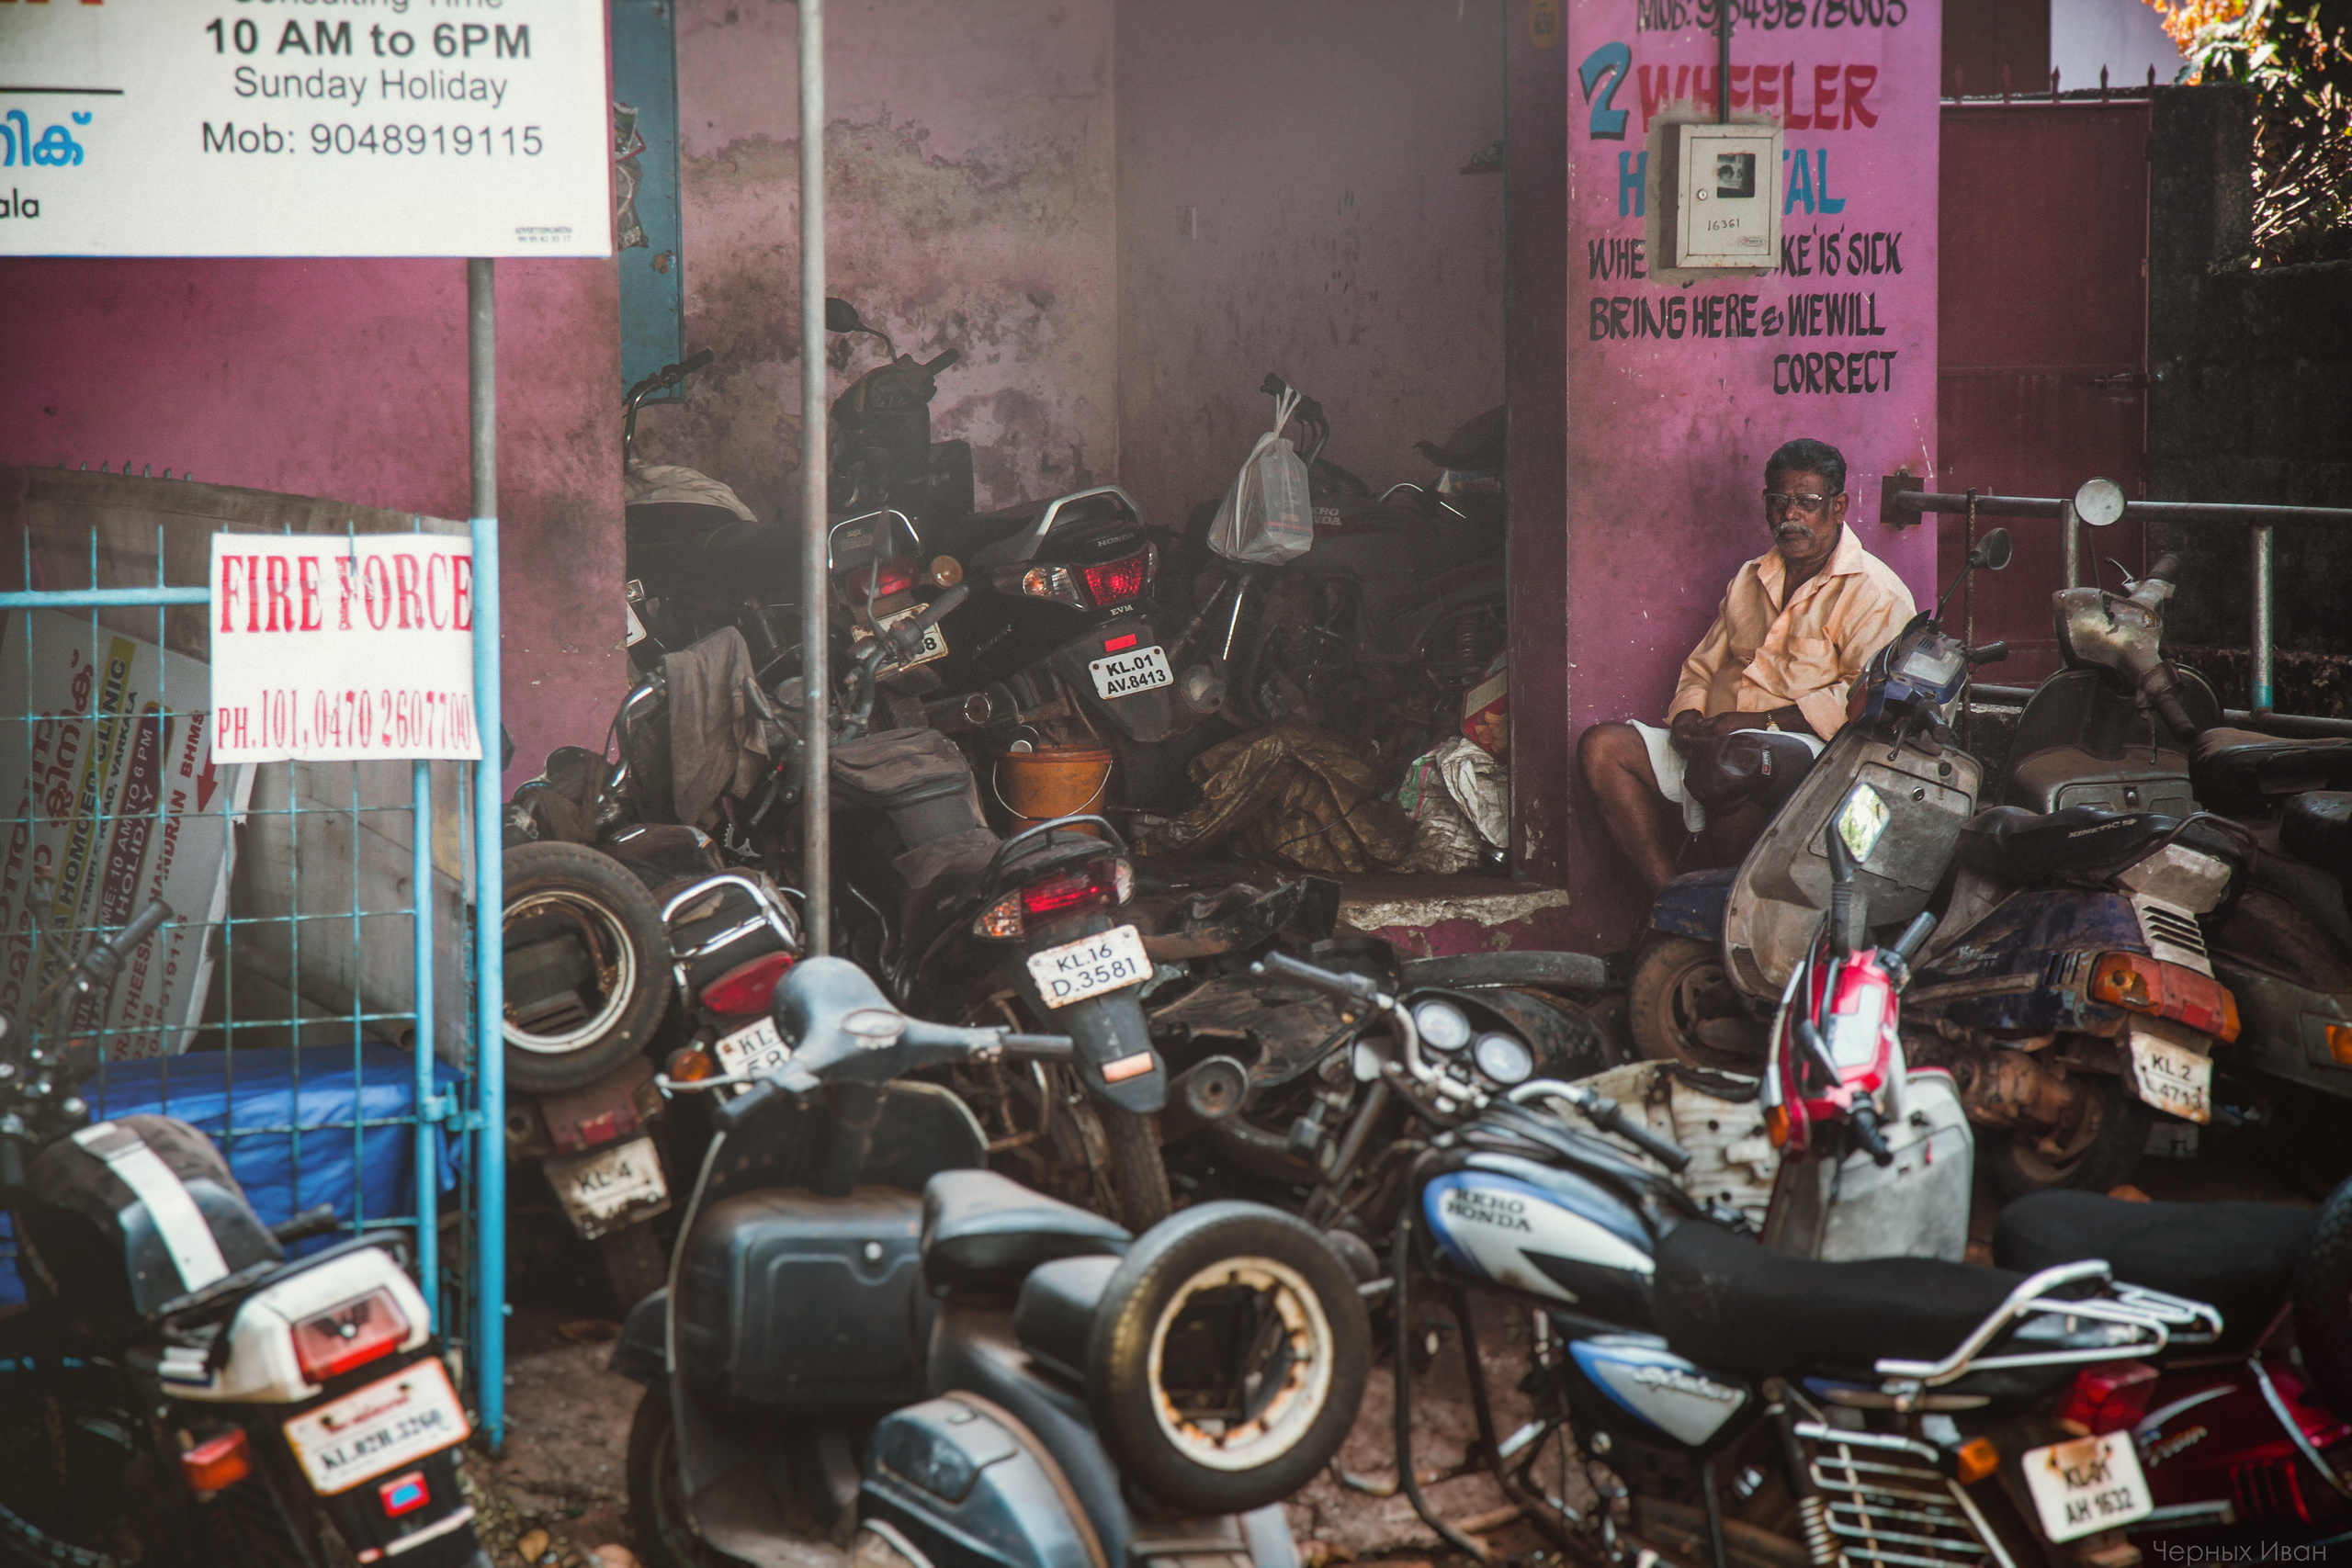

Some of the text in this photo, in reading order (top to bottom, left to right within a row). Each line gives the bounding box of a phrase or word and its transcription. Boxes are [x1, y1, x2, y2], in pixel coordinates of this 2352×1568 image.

[206, 18, 530, 59] 10 AM to 6PM
[234, 65, 507, 108] Sunday Holiday
[1578, 41, 1631, 141] 2
[203, 121, 543, 155] Mob: 9048919115
[1707, 218, 1740, 231] 16361
[1847, 231, 1905, 277] SICK
[1589, 296, 1687, 341] BRING
[1692, 293, 1759, 338] HERE
[1772, 350, 1898, 395] CORRECT
[1098, 532, 1136, 547] HONDA
[220, 553, 472, 633] FIRE FORCE
[1110, 604, 1134, 616] EVM
[1106, 654, 1154, 677] KL.01
[1106, 670, 1167, 695] AV.8413
[93, 659, 126, 762] CLINIC
[110, 692, 138, 777] VARKALA
[138, 728, 153, 761] PM
[134, 765, 144, 778] 6
[125, 784, 141, 809] TO
[149, 789, 187, 904] HANDRAN
[180, 712, 205, 778] BHMS
[116, 784, 154, 916] HOLIDAY
[118, 818, 133, 852] AM
[111, 855, 124, 876] 10
[1056, 943, 1113, 973] KL.16
[1052, 957, 1136, 997] D.3581
[1446, 1201, 1533, 1233] HONDA
